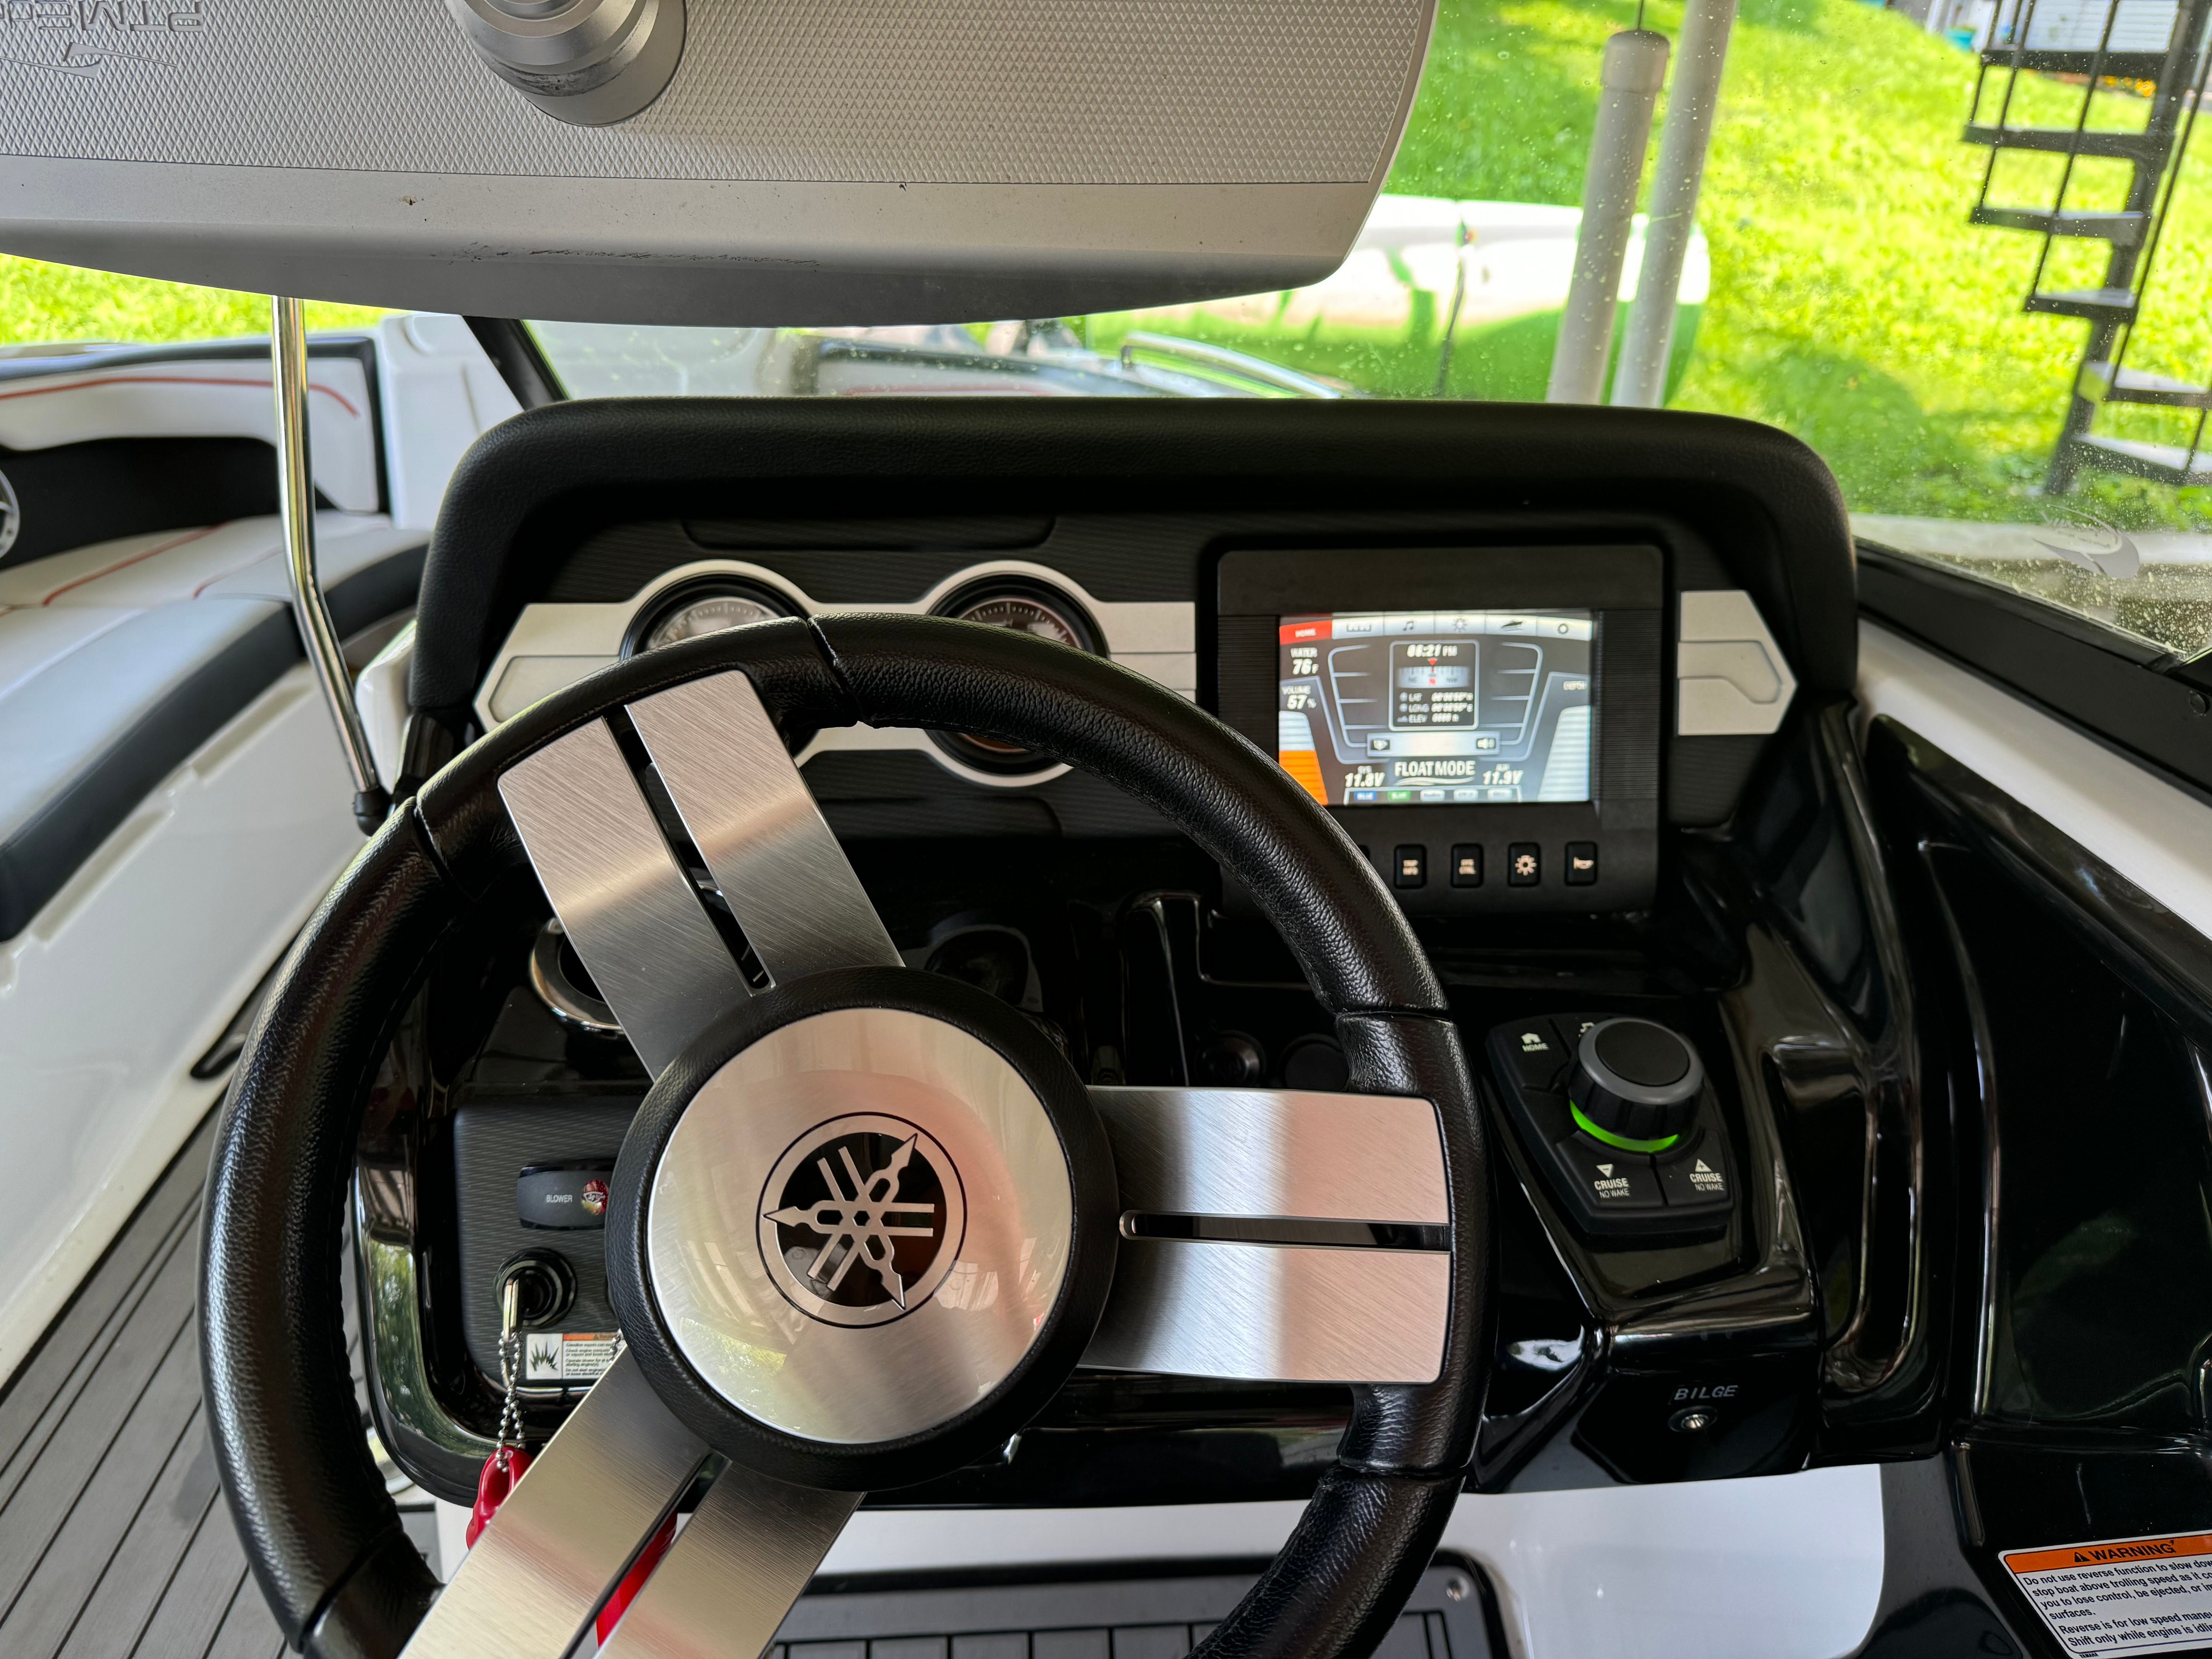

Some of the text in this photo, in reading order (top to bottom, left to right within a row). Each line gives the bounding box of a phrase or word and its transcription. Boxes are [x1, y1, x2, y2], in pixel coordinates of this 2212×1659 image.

[1290, 647, 1317, 658] WATER
[1293, 659, 1312, 675] 76
[1282, 685, 1311, 695] VOLUME
[1563, 681, 1587, 690] DEPTH
[1408, 693, 1422, 702] LAT
[1408, 703, 1430, 713] LONG
[1408, 714, 1428, 723] ELEV
[1395, 761, 1475, 776] FLOAT MODE
[1522, 1042, 1549, 1052] HOME
[1690, 1173, 1723, 1183] CRUISE
[1594, 1178, 1630, 1190] CRUISE
[1695, 1183, 1705, 1191] NO
[546, 1195, 573, 1203] BLOWER
[1599, 1188, 1631, 1199] NO WAKE
[1674, 1385, 1738, 1400] BILGE
[2088, 1543, 2176, 1561] WARNING
[2023, 1577, 2039, 1585] Do
[2040, 1575, 2057, 1583] not
[2077, 1570, 2114, 1580] reverse
[2114, 1565, 2157, 1576] function
[2169, 1562, 2193, 1570] slow
[2032, 1589, 2055, 1597] stop
[2054, 1584, 2079, 1594] boat
[2080, 1582, 2110, 1592] above
[2110, 1578, 2148, 1588] trolling
[2148, 1574, 2179, 1585] speed
[2040, 1600, 2061, 1610] you
[2071, 1596, 2095, 1604] lose
[2096, 1590, 2136, 1602] control,
[2134, 1589, 2150, 1597] be
[2150, 1585, 2191, 1597] ejected,
[2049, 1609, 2096, 1620] surfaces.
[2058, 1622, 2101, 1634] Reverse
[2100, 1621, 2113, 1629] is
[2112, 1619, 2129, 1628] for
[2128, 1618, 2148, 1626] low
[2150, 1613, 2182, 1625] speed
[2068, 1635, 2095, 1646] Shift
[2095, 1633, 2118, 1644] only
[2118, 1630, 2146, 1641] while
[2147, 1627, 2182, 1638] engine
[2181, 1625, 2194, 1634] is
